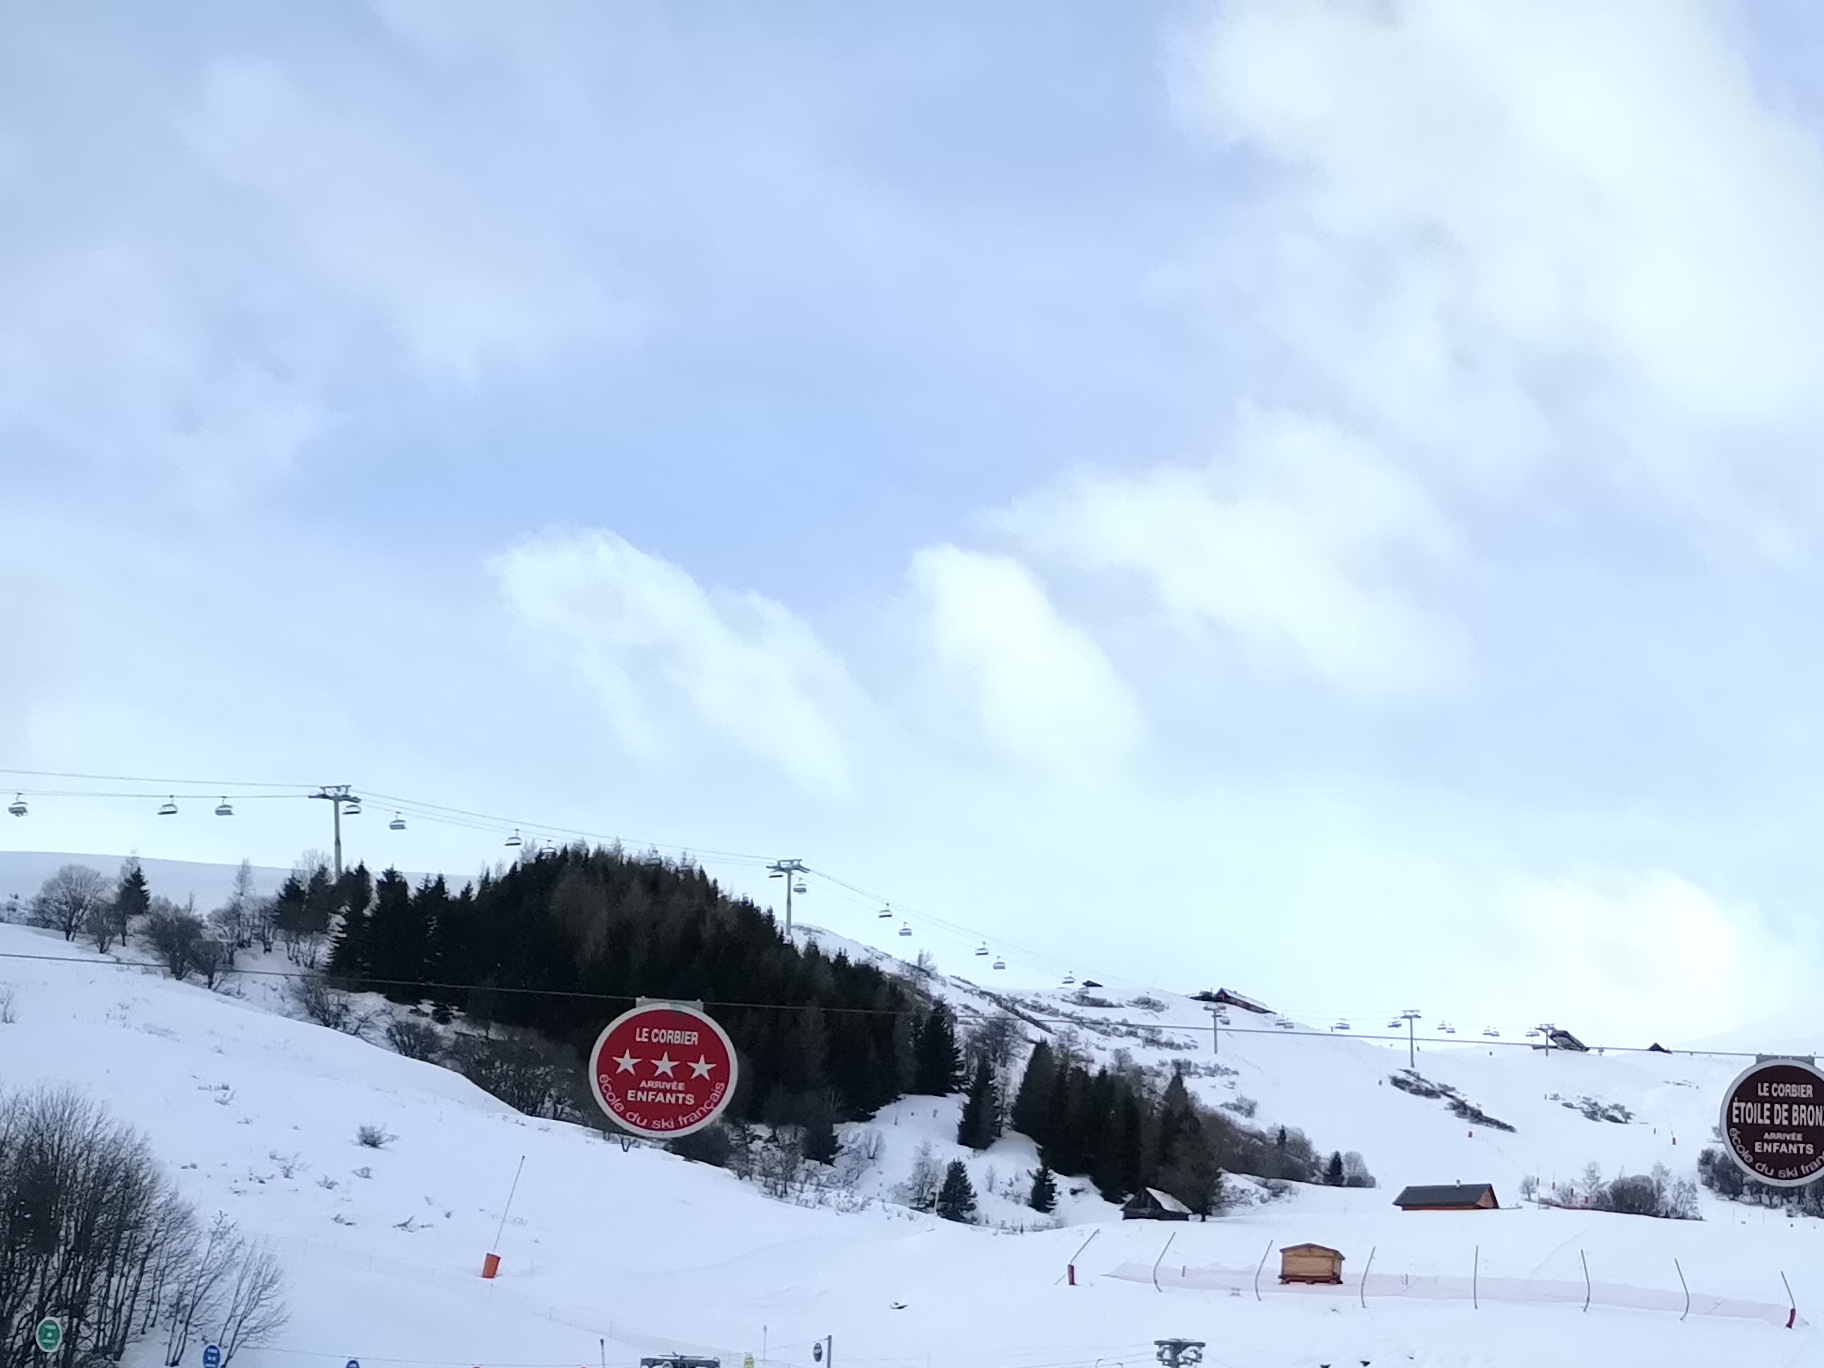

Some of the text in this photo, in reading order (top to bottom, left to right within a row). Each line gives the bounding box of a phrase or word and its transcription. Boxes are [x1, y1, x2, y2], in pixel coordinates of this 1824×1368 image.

[635, 1027, 699, 1045] LE CORBIER
[639, 1080, 685, 1091] ARRIVÉE
[1757, 1082, 1814, 1098] LE CORBIER
[599, 1073, 725, 1129] école du ski français
[627, 1090, 695, 1105] ENFANTS
[1732, 1096, 1771, 1125] ÉTOILE
[1773, 1103, 1789, 1126] DE
[1763, 1132, 1803, 1142] ARRIVÉE
[1729, 1127, 1754, 1164] école
[1755, 1163, 1774, 1176] du
[1778, 1167, 1798, 1178] ski
[1754, 1141, 1814, 1155] ENFANTS
